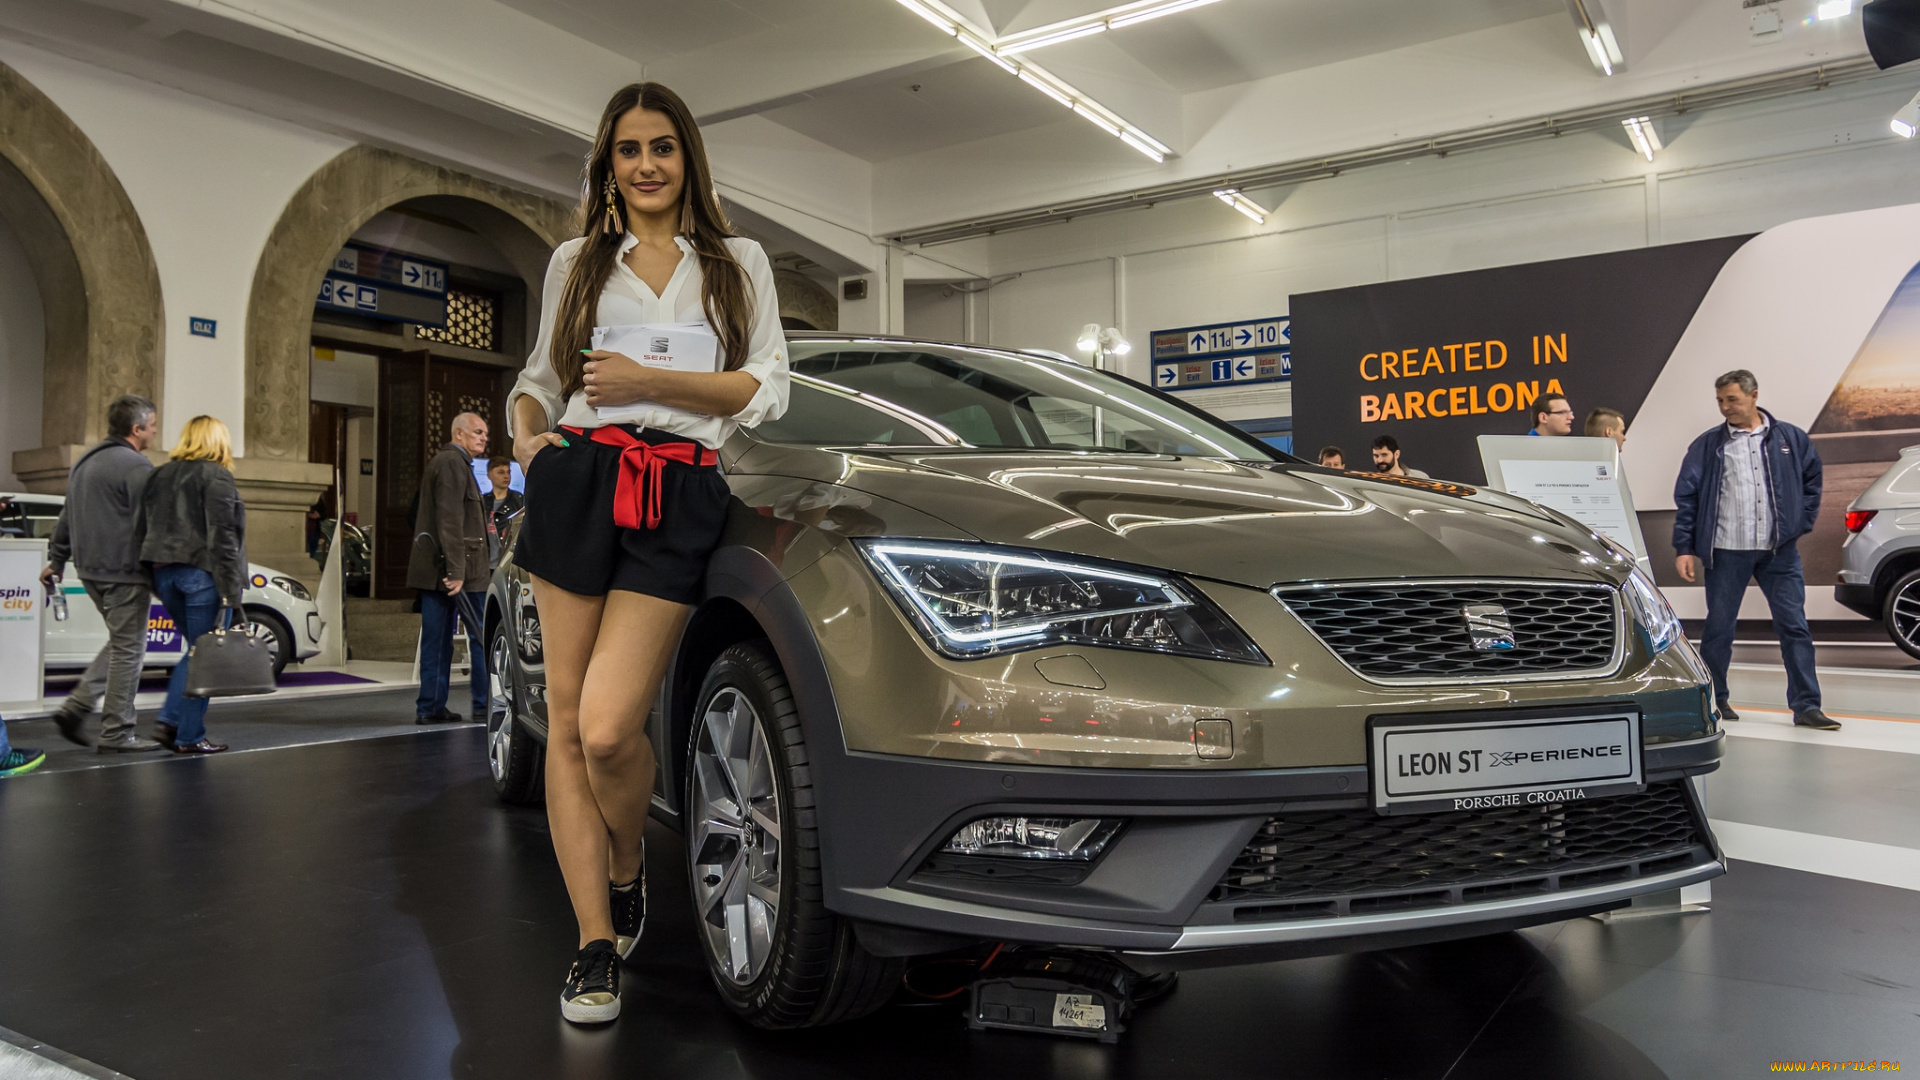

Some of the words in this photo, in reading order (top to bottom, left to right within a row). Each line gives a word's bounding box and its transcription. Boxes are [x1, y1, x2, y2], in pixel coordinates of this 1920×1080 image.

[322, 282, 331, 296] C
[1211, 331, 1231, 348] 11d
[1257, 326, 1276, 343] 10
[643, 354, 673, 362] SEAT
[1359, 340, 1508, 381] CREATED
[1533, 333, 1567, 365] IN
[0, 586, 30, 600] spin
[3, 598, 33, 612] city
[148, 615, 174, 629] pin
[1398, 752, 1451, 777] LEON
[1458, 750, 1483, 773] ST
[1453, 794, 1521, 810] PORSCHE
[1526, 788, 1586, 803] CROATIA
